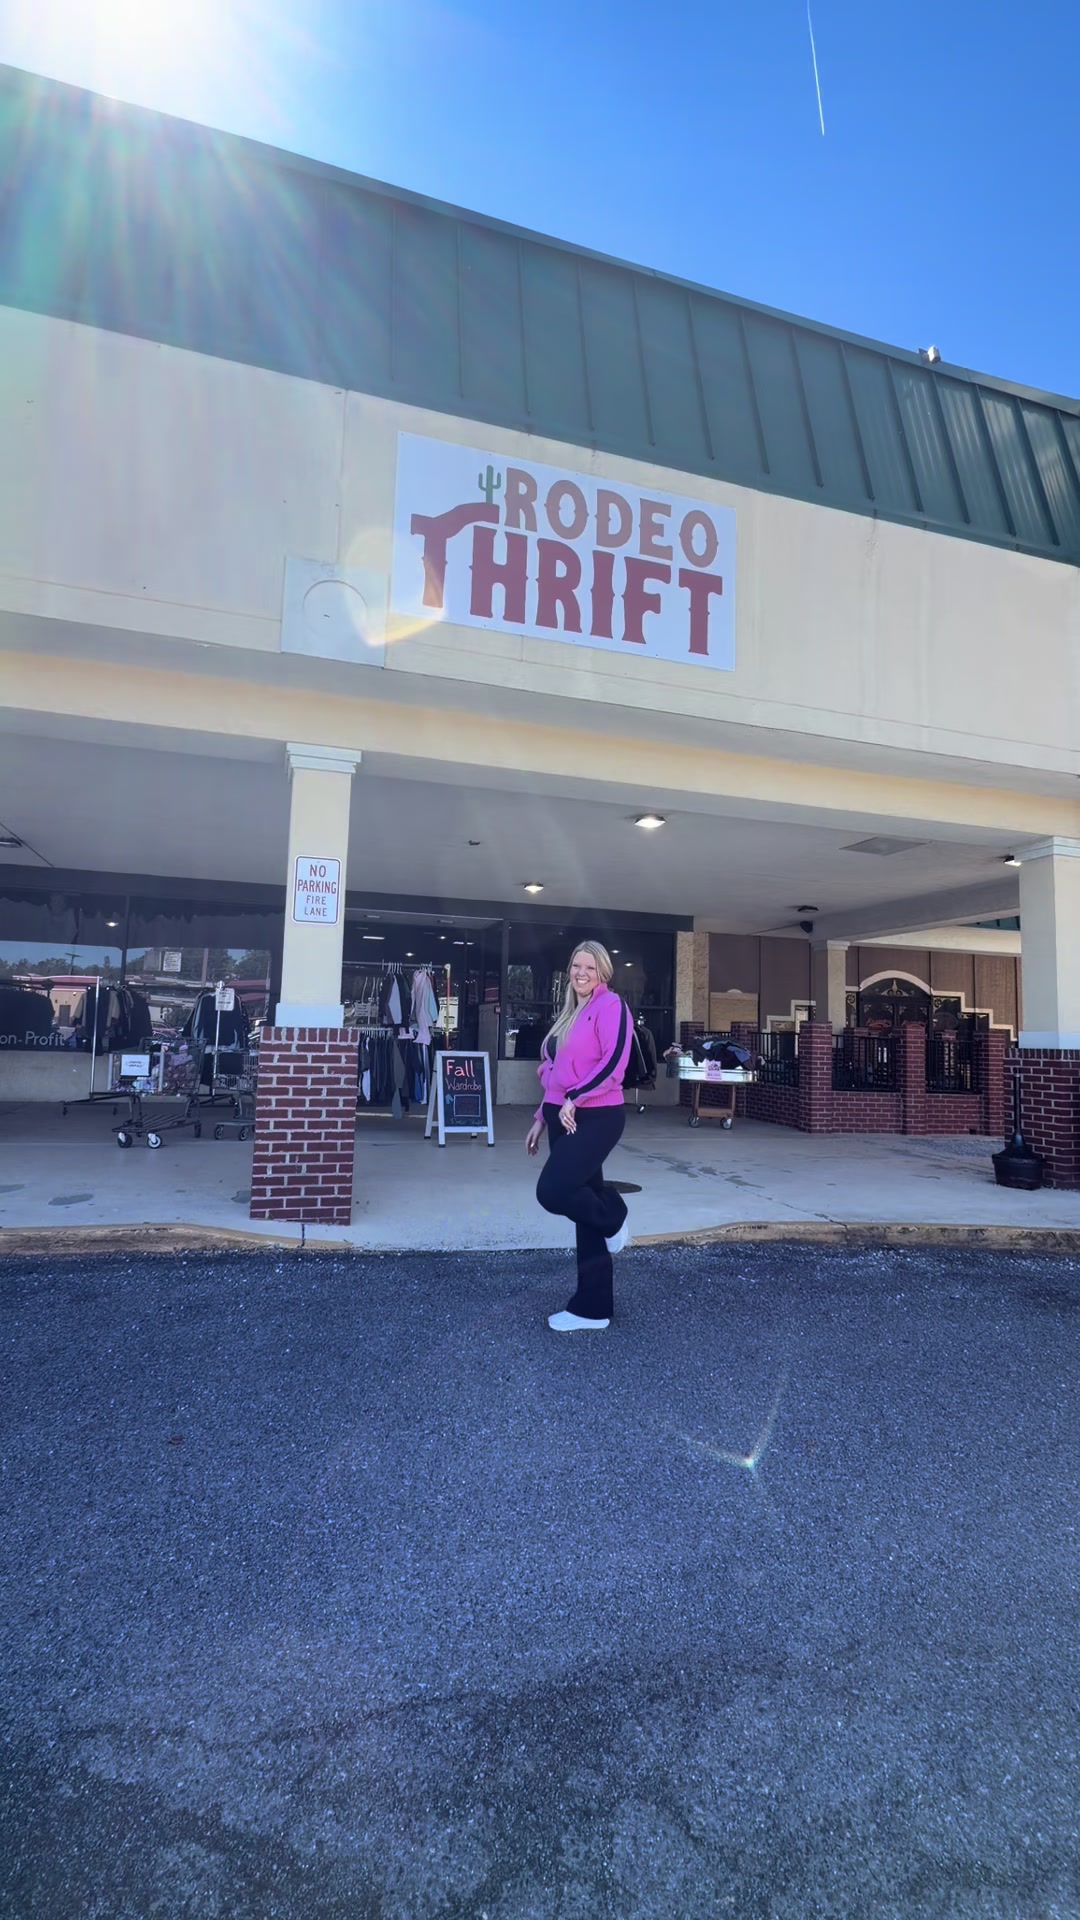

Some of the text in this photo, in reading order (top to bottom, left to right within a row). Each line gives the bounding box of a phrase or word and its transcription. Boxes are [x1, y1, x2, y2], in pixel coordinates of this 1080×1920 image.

[504, 467, 719, 568] RODEO
[410, 502, 723, 656] THRIFT
[309, 864, 327, 878] NO
[297, 879, 337, 894] PARKING
[306, 895, 327, 905] FIRE
[304, 907, 328, 917] LANE
[445, 1059, 475, 1077] Fall
[445, 1078, 482, 1091] Wardrobe
